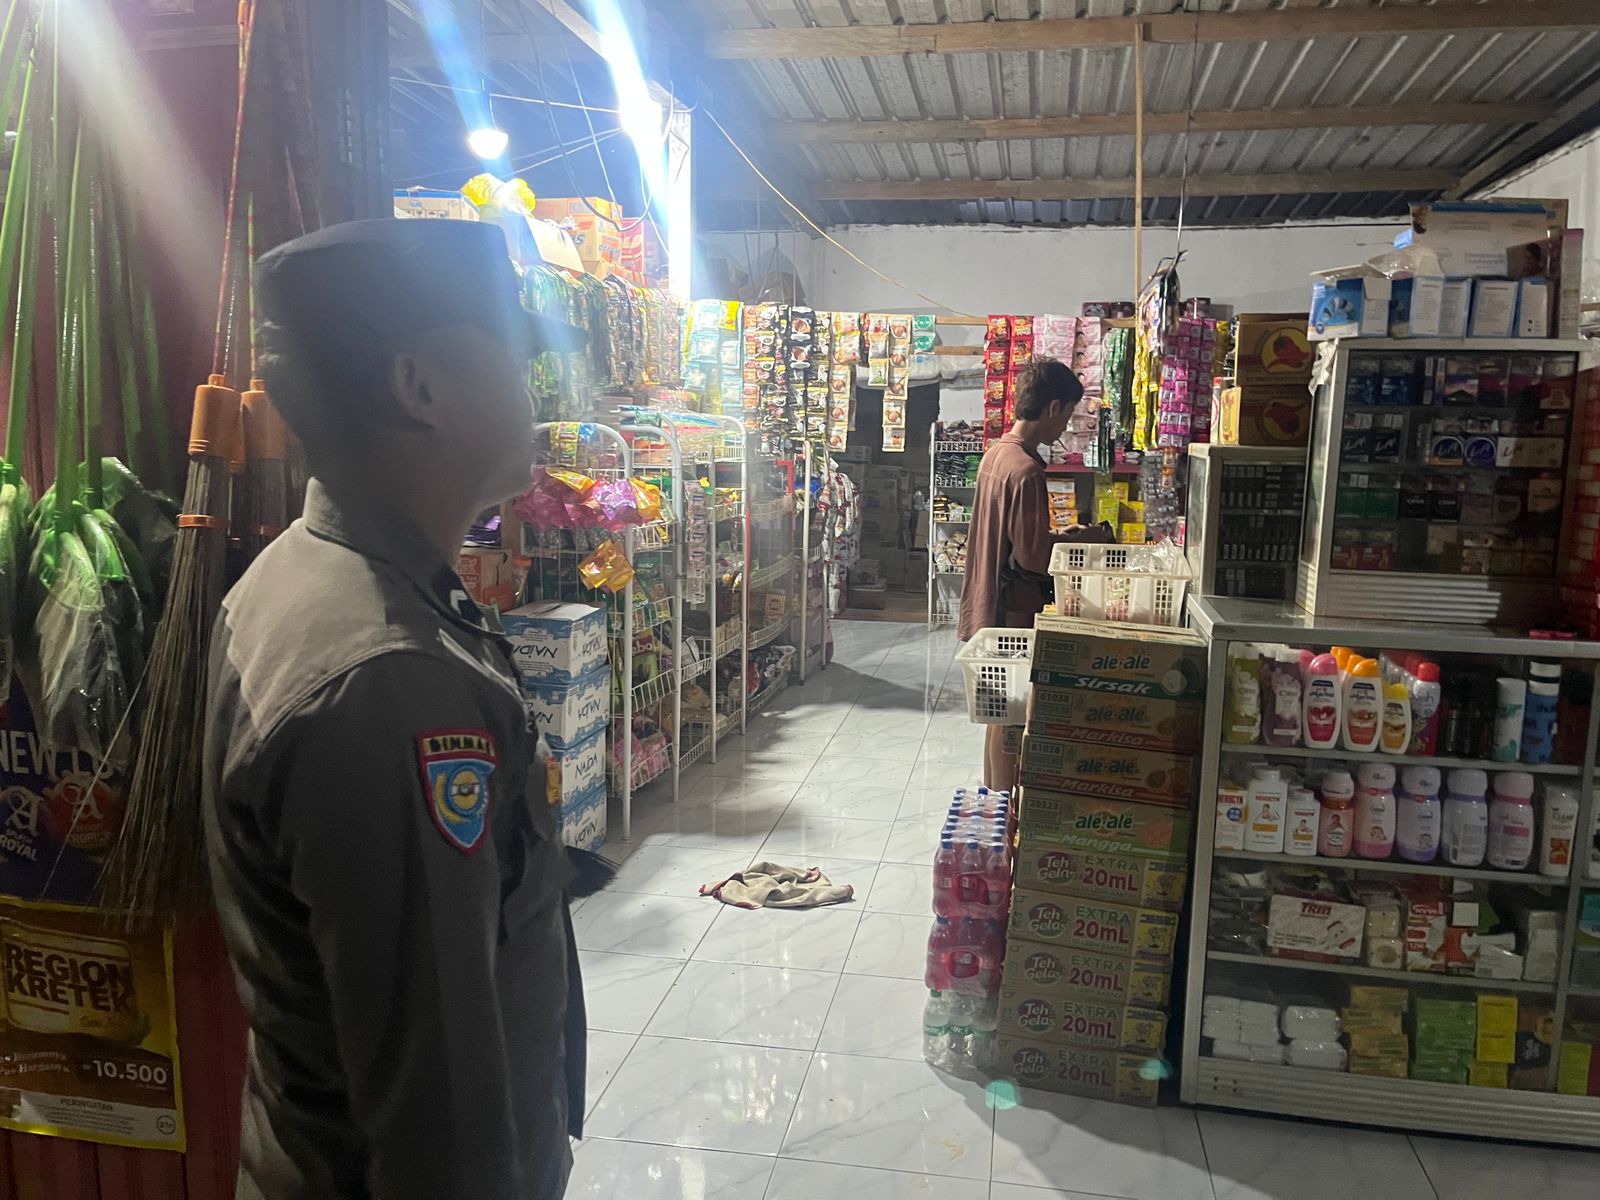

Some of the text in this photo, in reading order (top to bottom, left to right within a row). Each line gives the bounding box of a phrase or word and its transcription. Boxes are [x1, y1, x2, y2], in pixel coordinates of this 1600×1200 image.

[1074, 677, 1152, 694] Sirsak
[1070, 728, 1145, 745] Markisa
[1061, 780, 1135, 797] Markisa
[0, 835, 37, 862] ROYAL
[1060, 834, 1133, 852] Mangga
[1045, 856, 1069, 869] Teh
[1085, 855, 1139, 873] EXTRA
[1083, 867, 1138, 891] 20mL
[1037, 907, 1061, 920] Teh
[1076, 906, 1131, 926] EXTRA
[1074, 919, 1129, 944] 20mL
[5, 943, 131, 987] REGION
[1032, 956, 1056, 968] Teh
[1071, 955, 1125, 972] EXTRA
[1069, 967, 1123, 991] 20mL
[8, 973, 134, 1016] KRETEK
[1025, 1003, 1049, 1016] Teh
[1064, 1002, 1118, 1019] EXTRA
[1062, 1015, 1117, 1039] 20mL
[1020, 1051, 1044, 1064] Teh
[1059, 1050, 1111, 1067] EXTRA
[1057, 1063, 1112, 1087] 20mL
